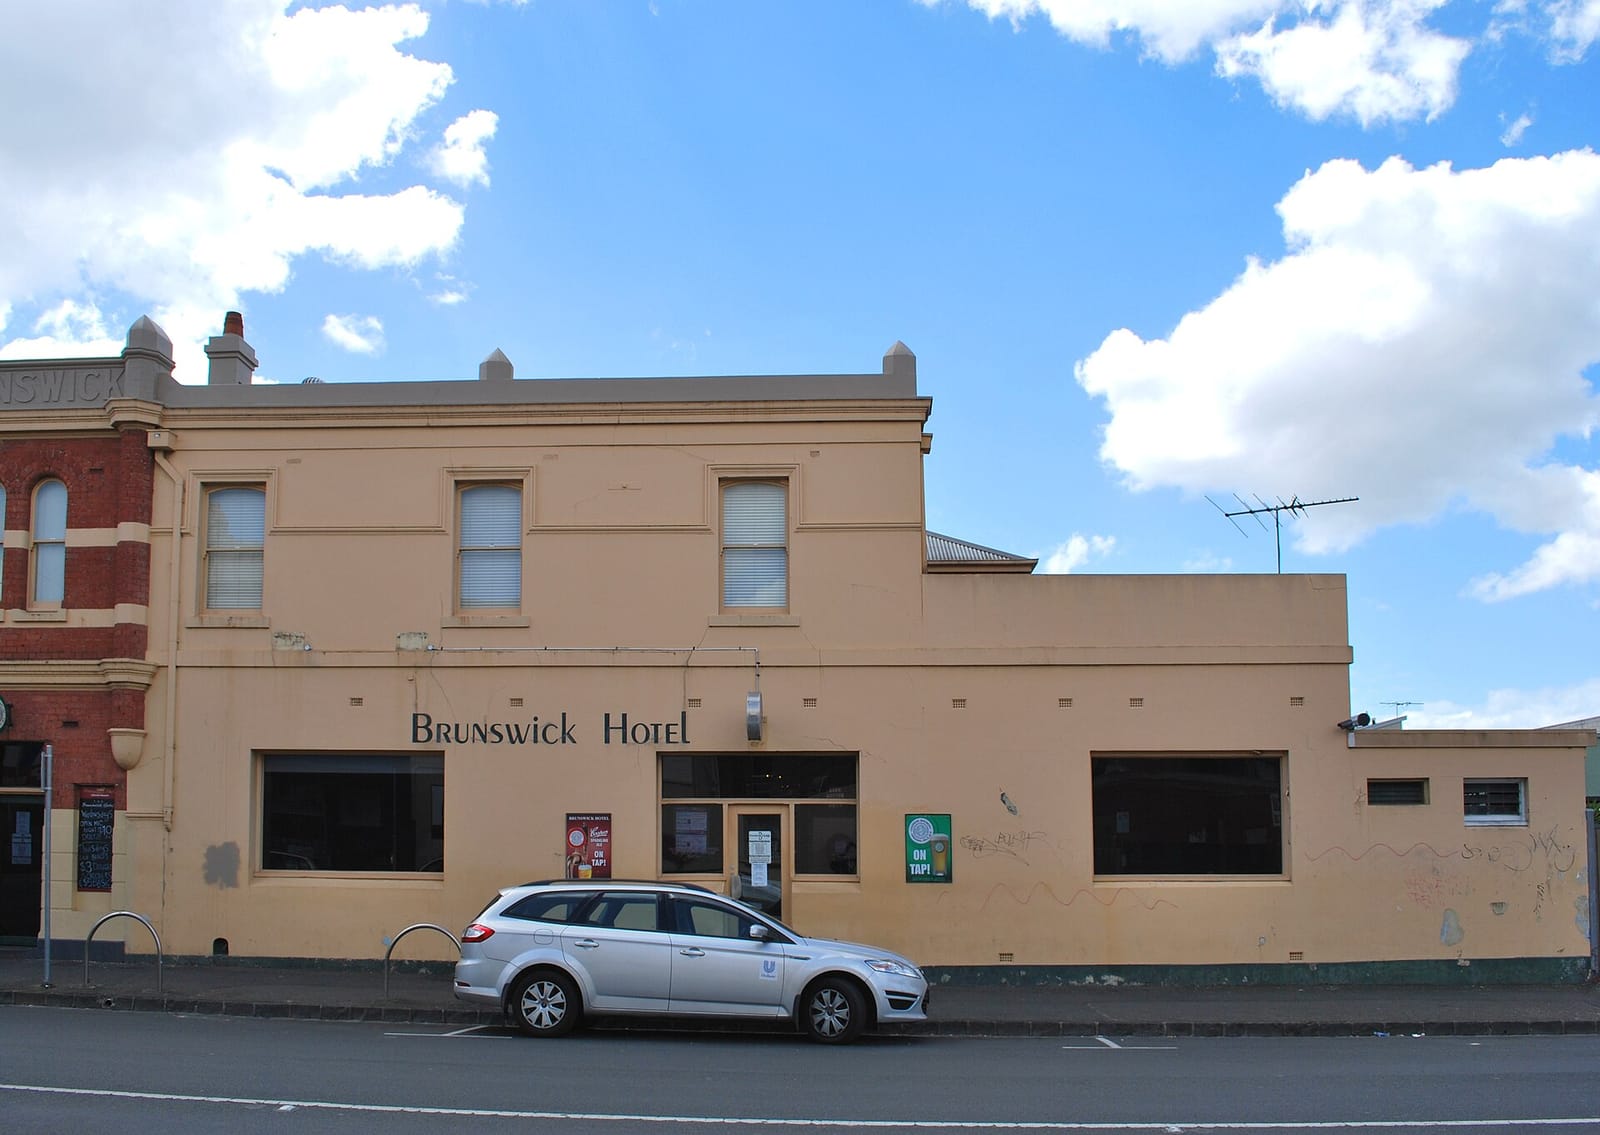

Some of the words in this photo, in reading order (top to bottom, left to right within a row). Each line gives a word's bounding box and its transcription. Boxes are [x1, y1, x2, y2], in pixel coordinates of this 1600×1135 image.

[594, 850, 604, 858] ON
[913, 849, 927, 861] ON
[591, 859, 606, 867] TAP!
[909, 863, 930, 875] TAP!
